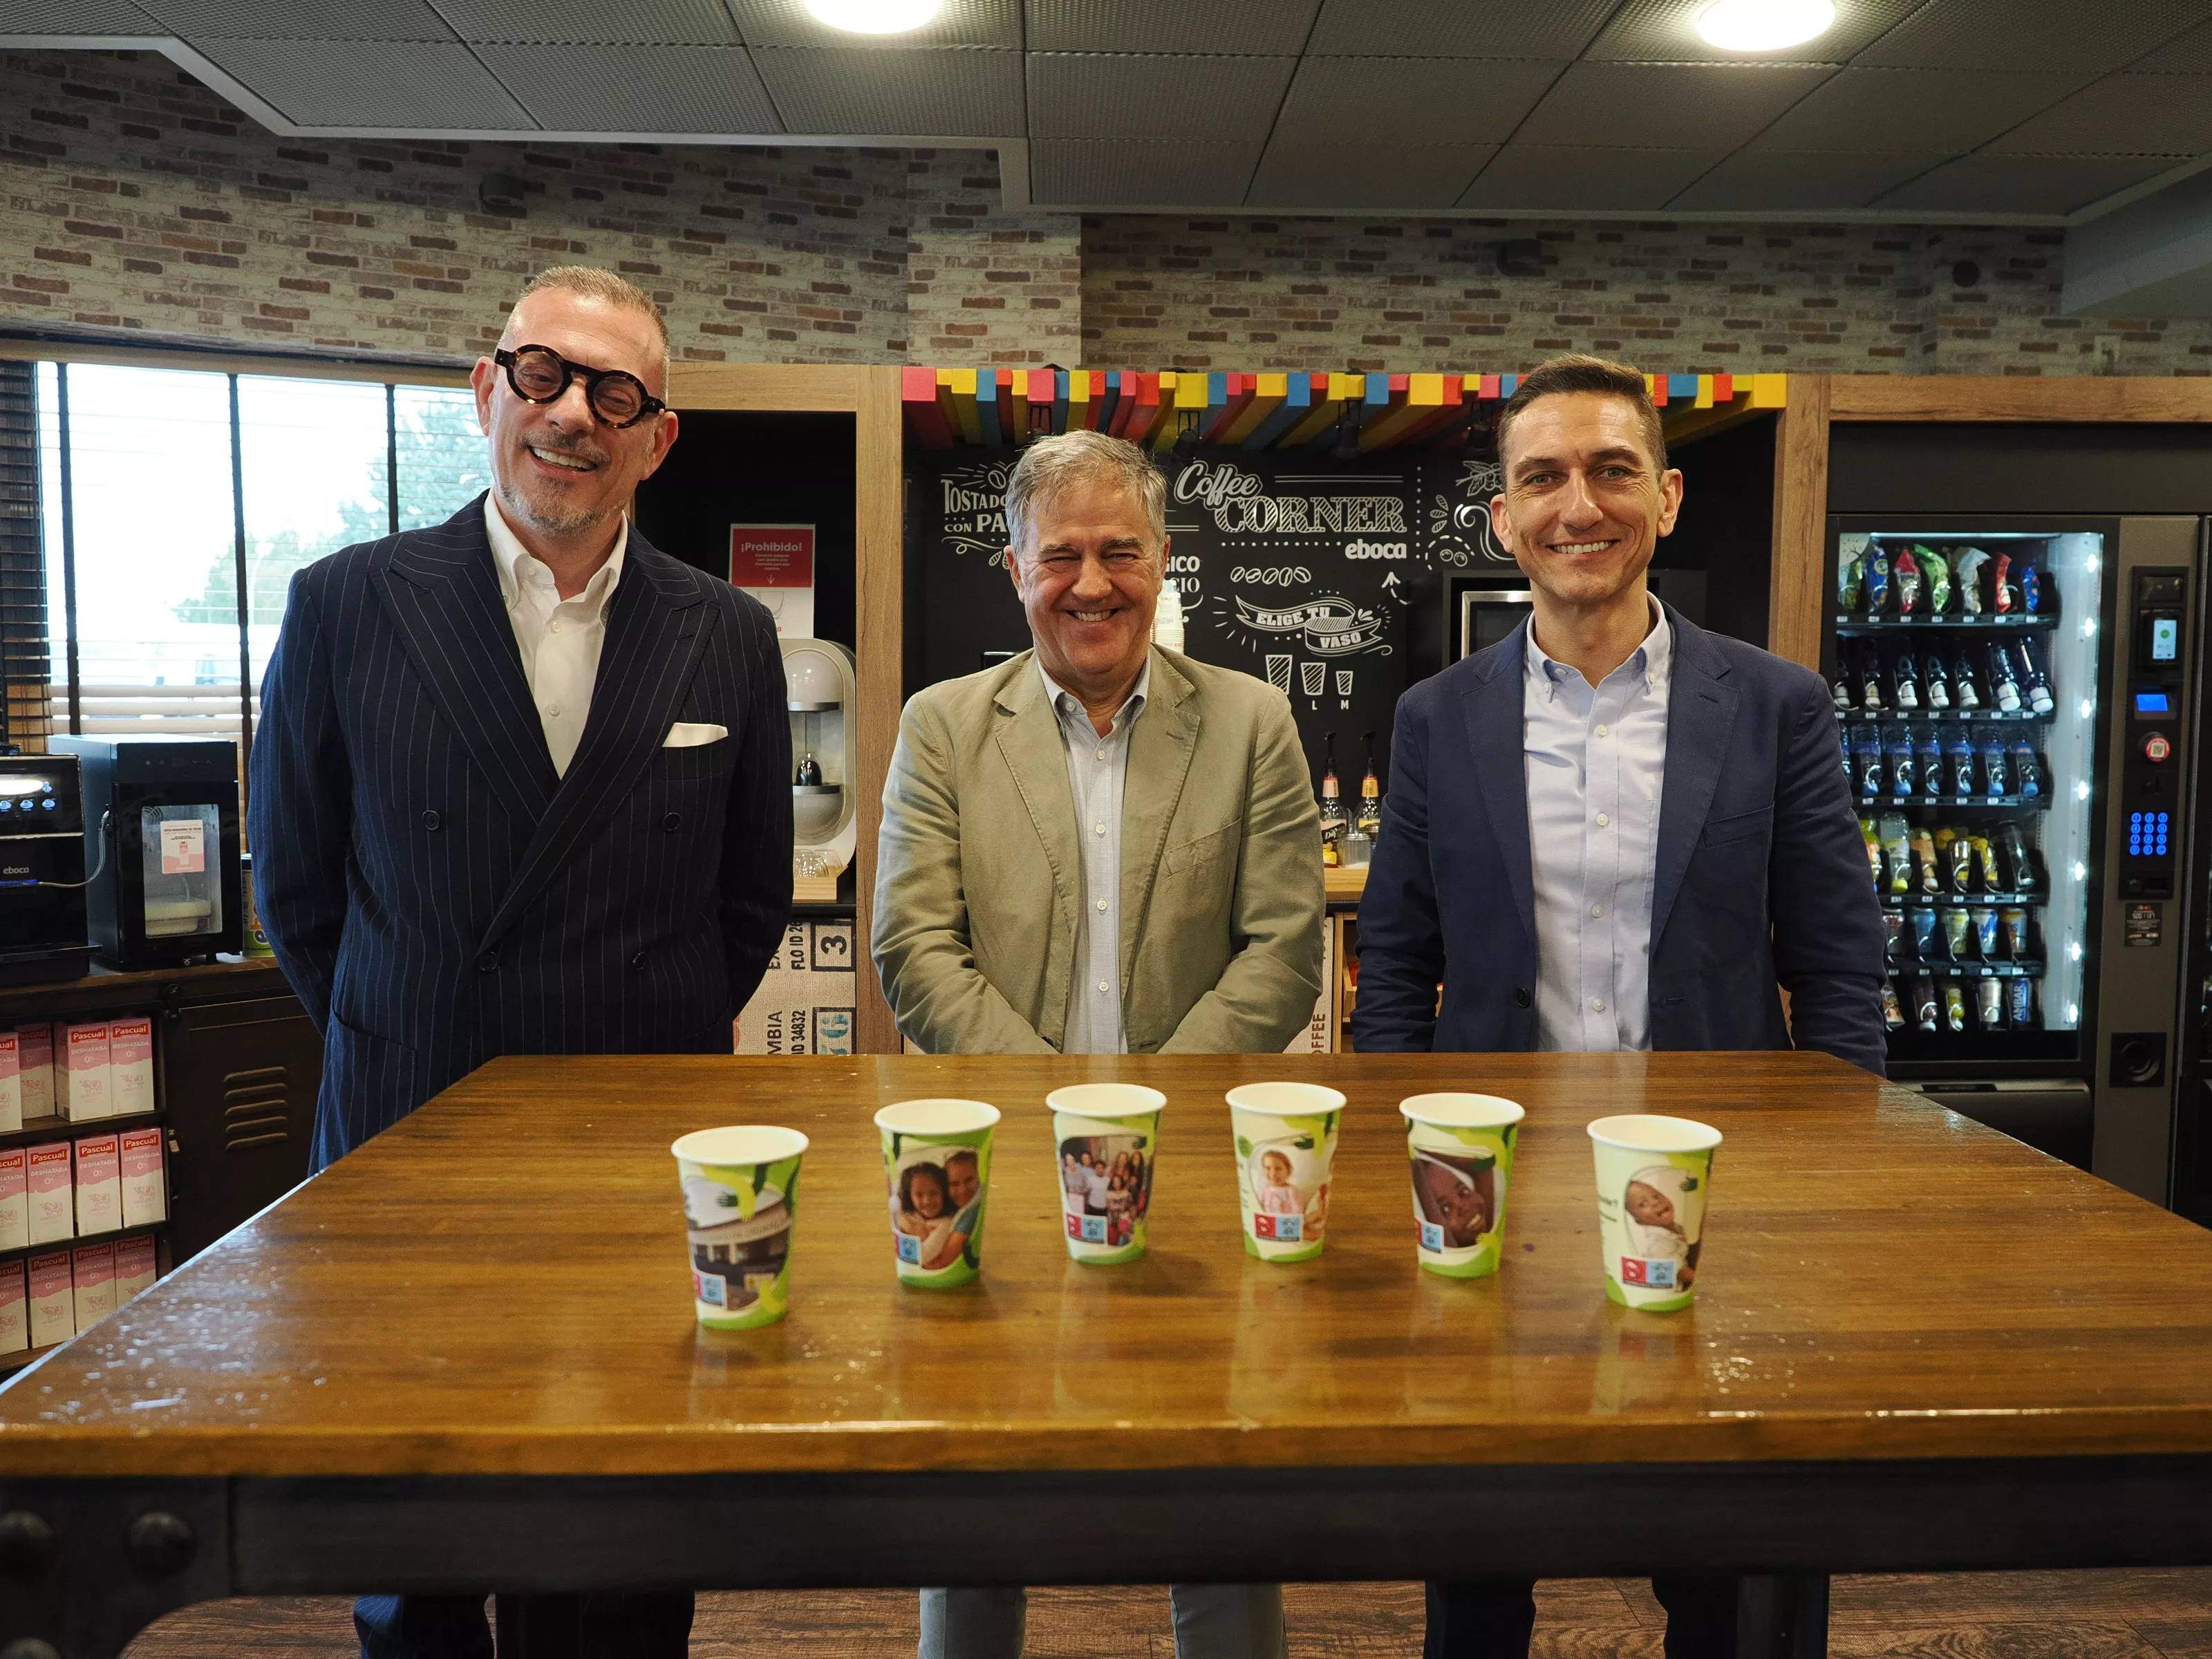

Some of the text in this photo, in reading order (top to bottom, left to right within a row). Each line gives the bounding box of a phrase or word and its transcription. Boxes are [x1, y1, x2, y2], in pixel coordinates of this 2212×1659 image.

[1177, 462, 1260, 506] Coffee
[1214, 495, 1407, 533] CORNER
[944, 512, 1009, 532] CON PA
[741, 541, 803, 552] ¡Prohibido!
[1344, 538, 1407, 559] eboca
[1166, 555, 1201, 573] ICO
[1255, 606, 1331, 626] ELIGE TU
[1320, 631, 1362, 648] VASO
[1312, 699, 1349, 711] L M
[3, 866, 30, 874] eboca
[789, 936, 804, 946] ID
[821, 935, 847, 955] 3
[790, 950, 806, 971] FLO
[2013, 984, 2023, 1022] AMBAR
[115, 1025, 147, 1035] Pascual
[790, 1010, 806, 1042] 34832
[73, 1029, 104, 1040] Pascual
[766, 1010, 782, 1055] MBIA
[1311, 1013, 1326, 1055] FFEE
[126, 1136, 156, 1147] Pascual
[82, 1143, 113, 1154] Pascual
[32, 1151, 65, 1162] Pascual
[0, 1158, 20, 1168] scual
[30, 1167, 68, 1177] DESNATADA
[120, 1238, 150, 1250] Pascual
[79, 1246, 109, 1258] Pascual
[34, 1255, 66, 1268] Pascual
[0, 1264, 19, 1275] scual
